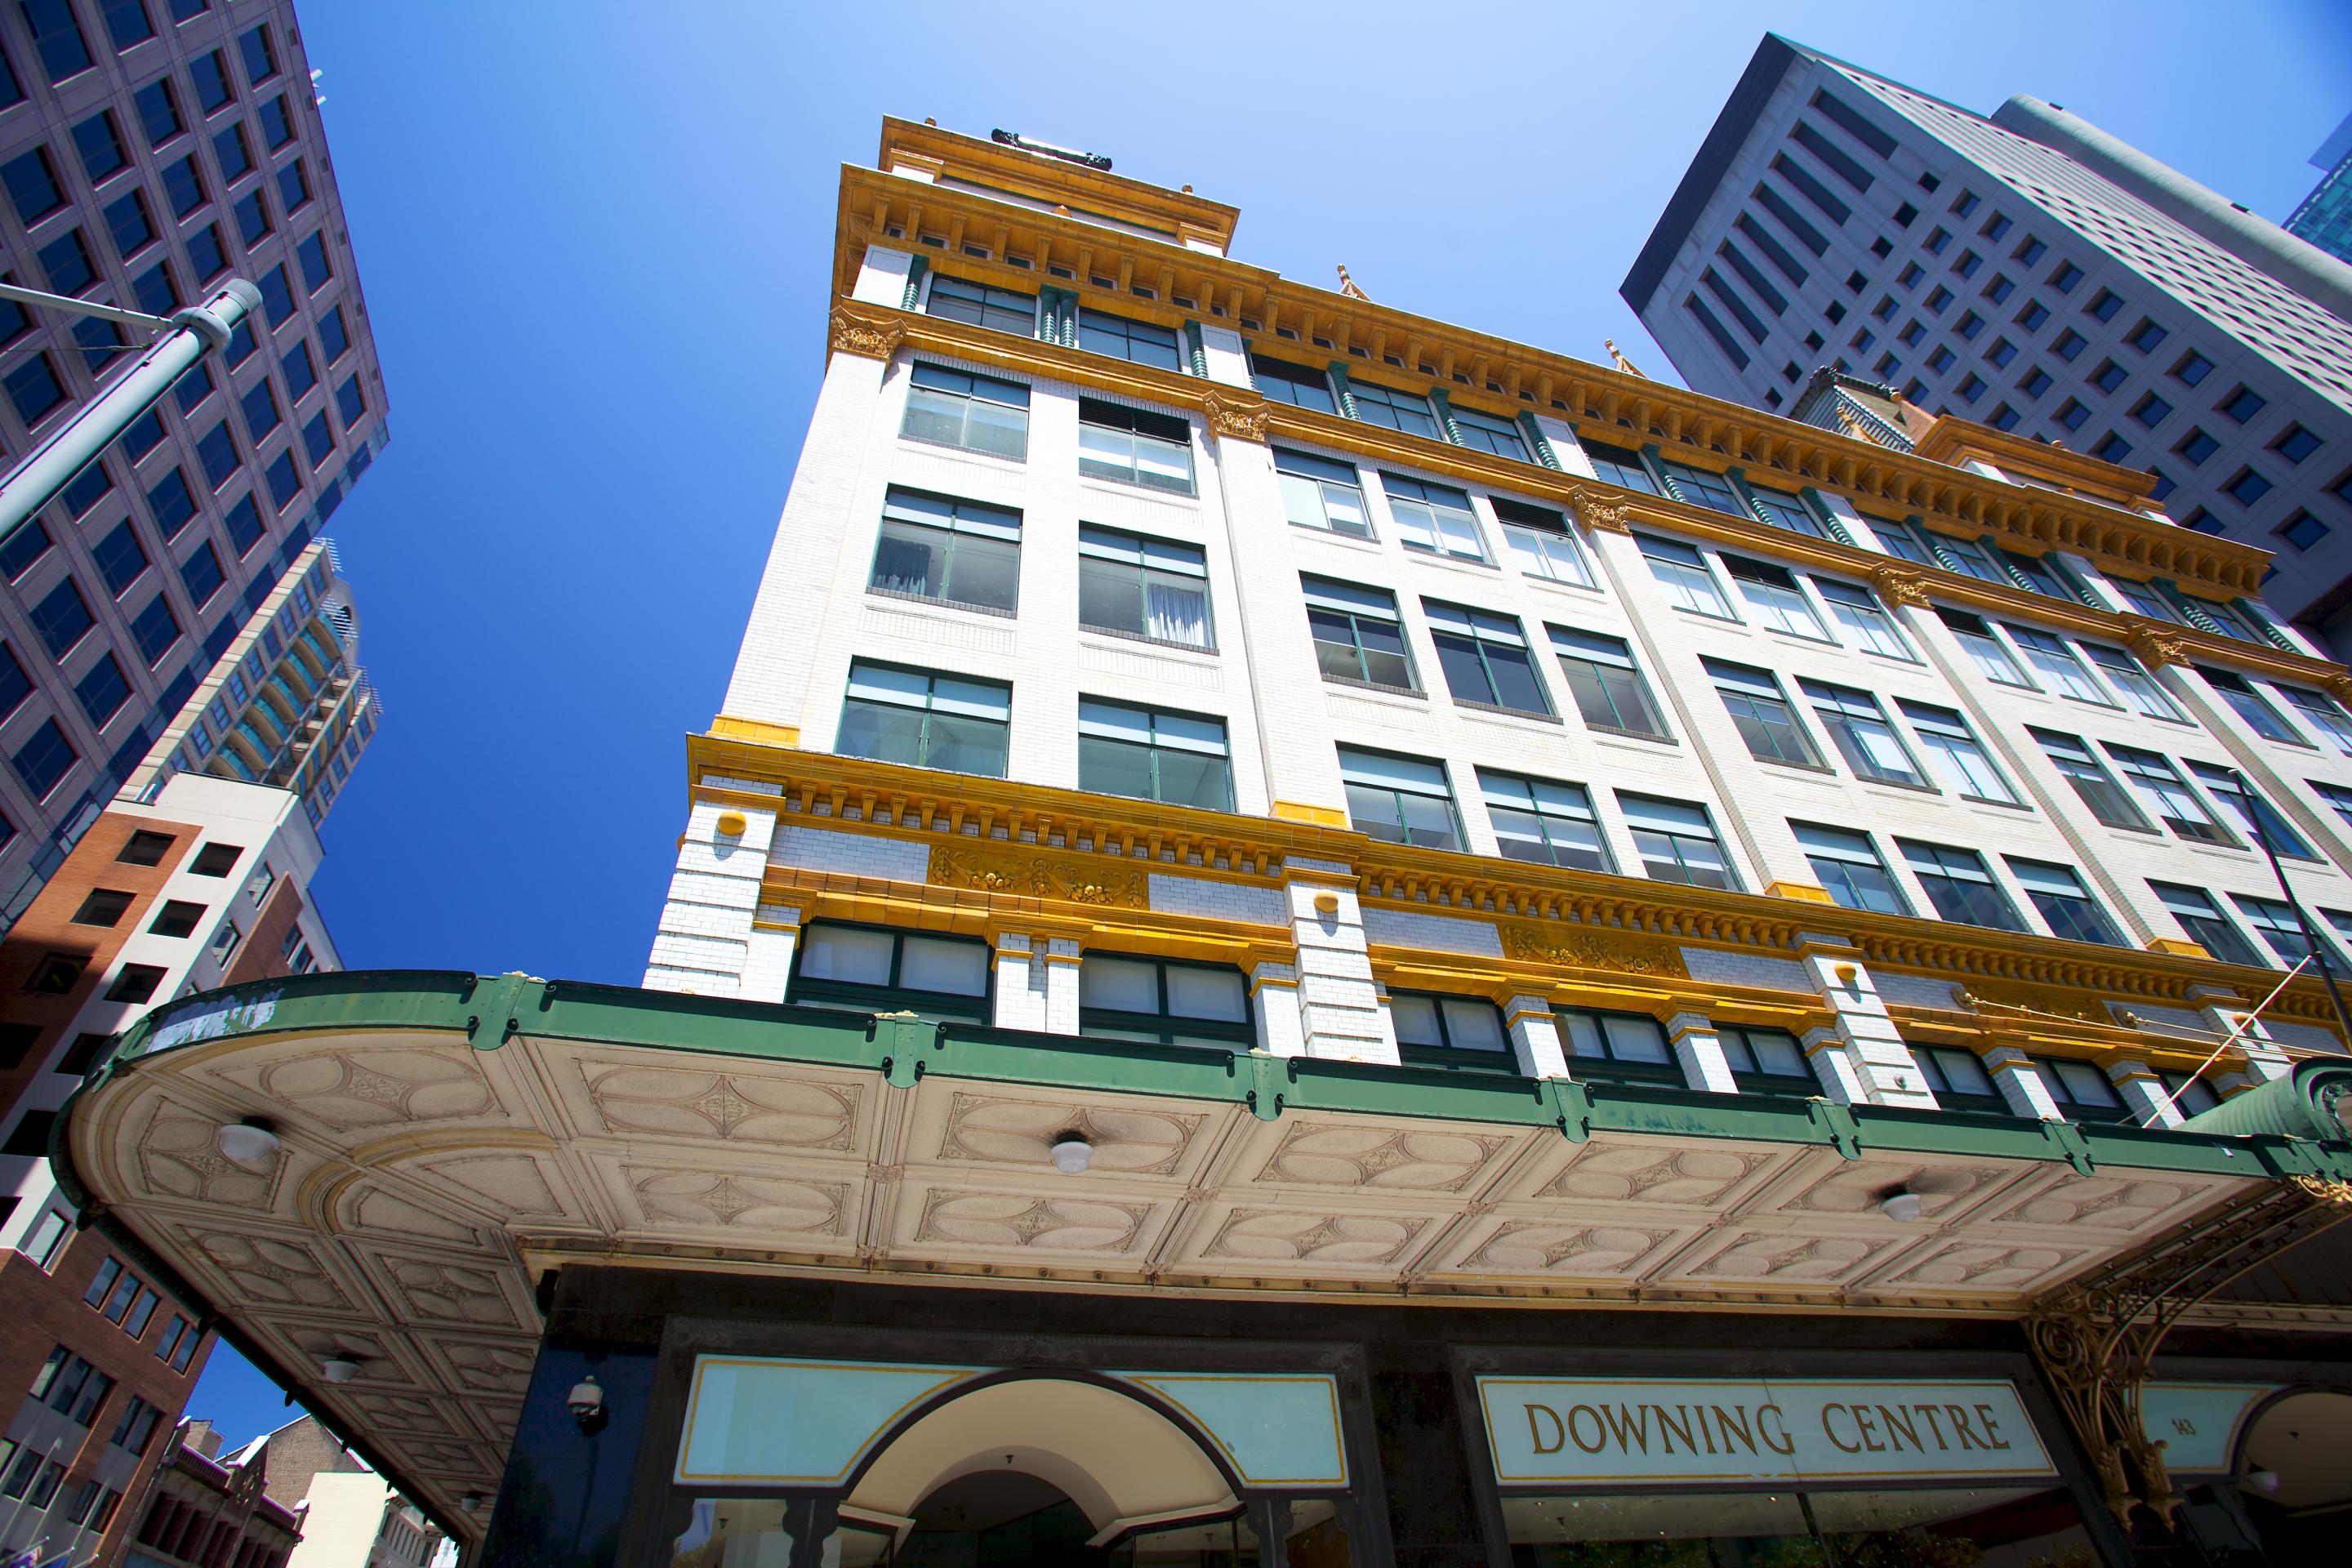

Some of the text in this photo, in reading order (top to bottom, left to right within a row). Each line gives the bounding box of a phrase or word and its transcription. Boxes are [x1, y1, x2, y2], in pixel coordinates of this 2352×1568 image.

[1523, 1402, 2011, 1457] DOWNING CENTRE
[2171, 1418, 2196, 1435] 143
